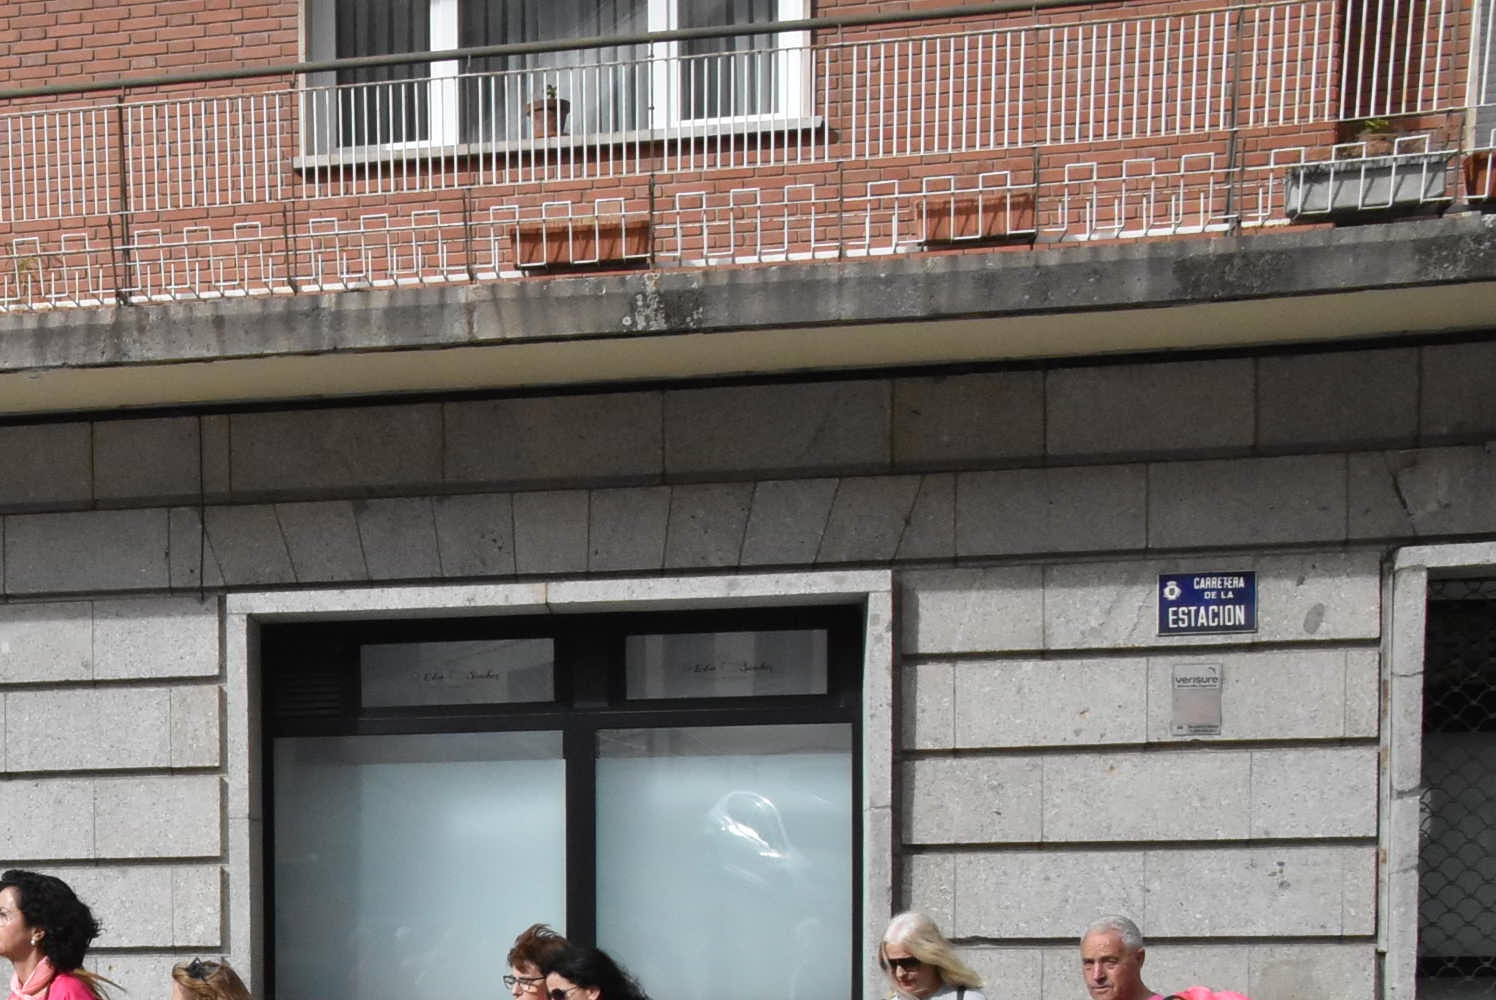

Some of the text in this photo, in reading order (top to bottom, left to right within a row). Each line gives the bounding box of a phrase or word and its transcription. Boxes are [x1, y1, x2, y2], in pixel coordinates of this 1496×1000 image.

[1193, 576, 1245, 590] CARRETERA
[1204, 591, 1234, 600] DE LA
[1168, 605, 1245, 628] ESTACION
